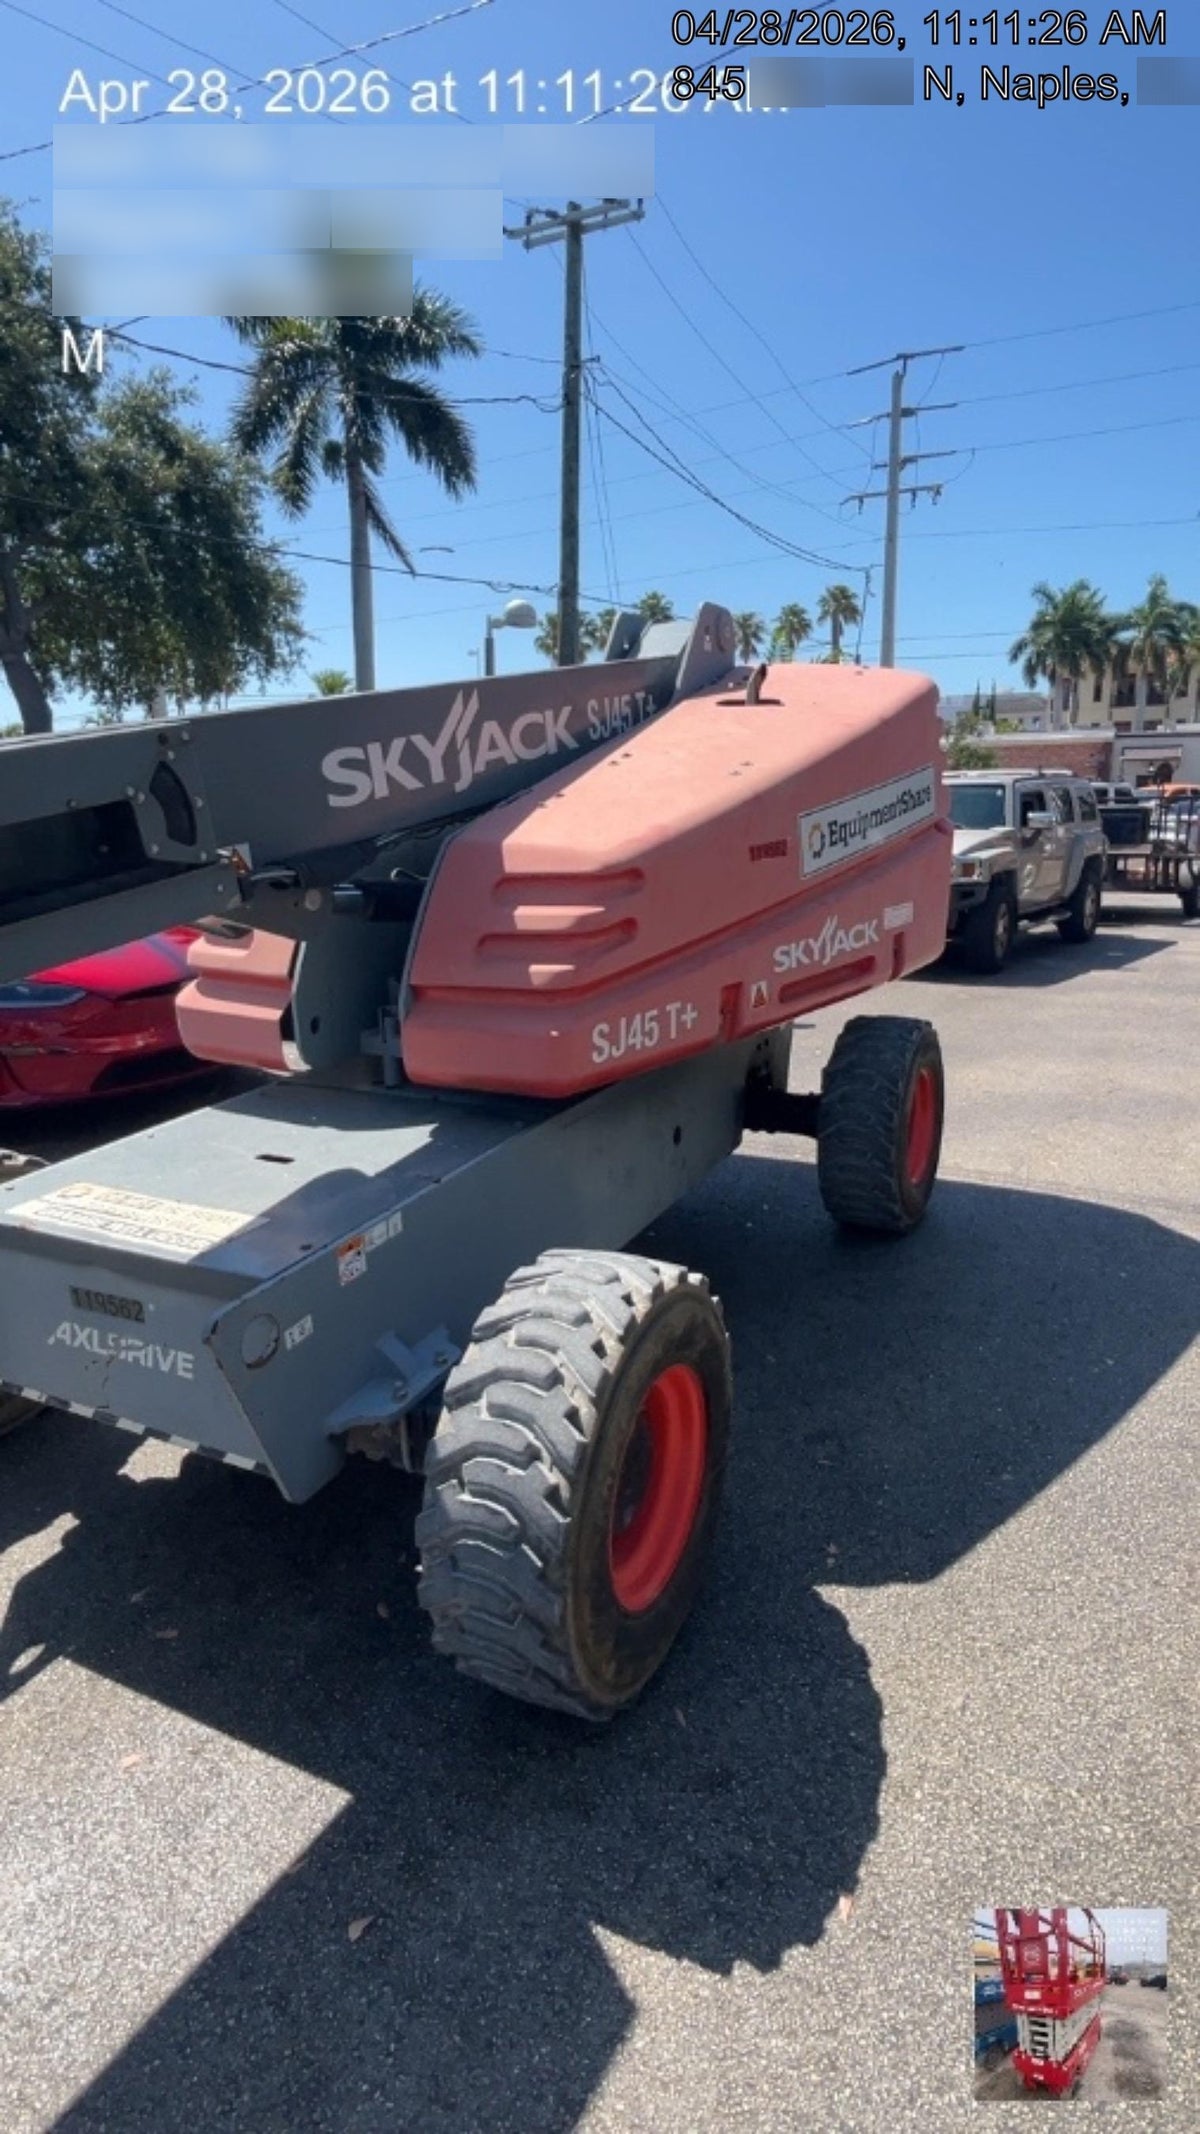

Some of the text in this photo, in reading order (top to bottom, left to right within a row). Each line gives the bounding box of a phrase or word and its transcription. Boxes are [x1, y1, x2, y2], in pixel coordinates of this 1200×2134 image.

[321, 688, 580, 807] SKYJACK
[827, 784, 931, 848] EquipmentShare
[773, 915, 879, 973] SKYJACK
[592, 1002, 698, 1063] SJ45 T+
